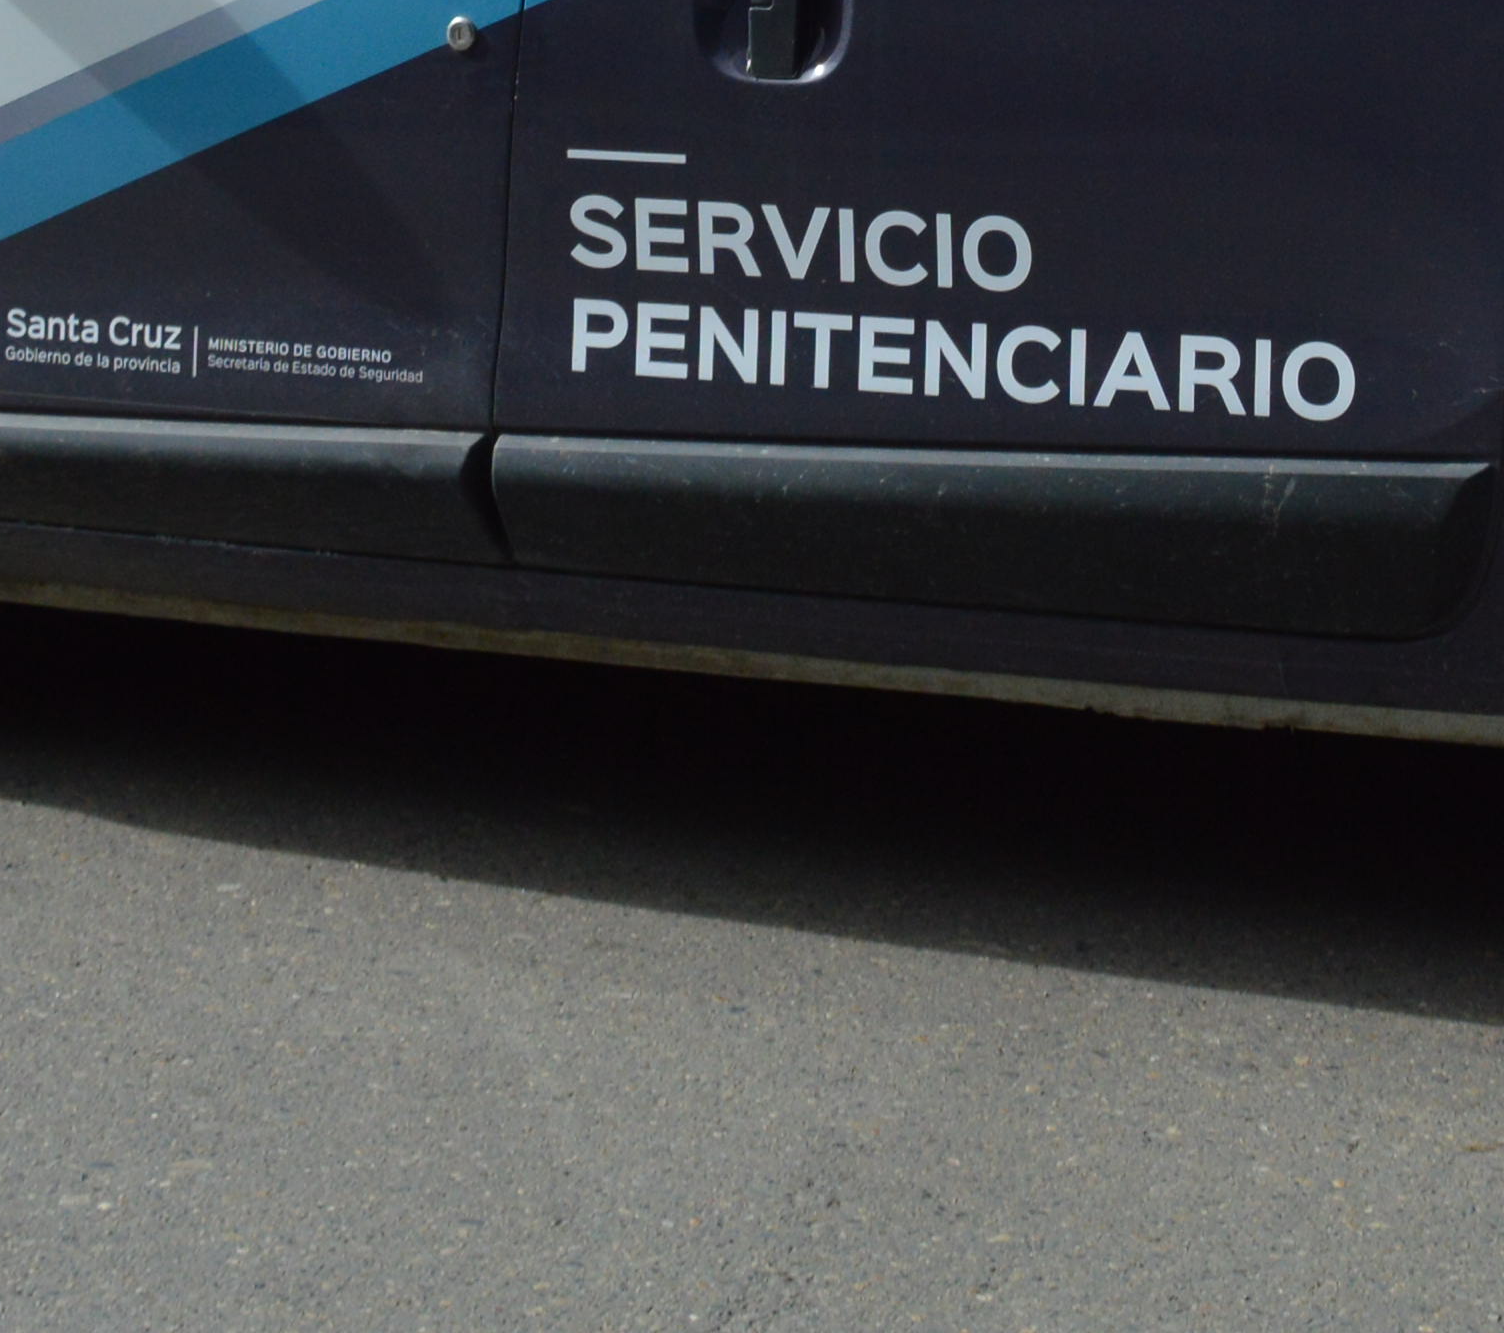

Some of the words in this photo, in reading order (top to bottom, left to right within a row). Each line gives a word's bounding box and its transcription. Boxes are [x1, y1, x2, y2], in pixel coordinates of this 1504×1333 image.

[569, 193, 1033, 293] SERVICIO
[5, 307, 100, 345] Santa
[108, 315, 183, 351] Cruz
[4, 345, 72, 366] Gobierno
[74, 351, 93, 367] de
[97, 353, 110, 369] la
[113, 354, 181, 374] provincia
[207, 336, 289, 357] MINISTERIO
[292, 343, 313, 358] DE
[315, 345, 393, 364] GOBIERNO
[571, 297, 1356, 422] PENITENCIARIO
[273, 358, 289, 374] de
[291, 360, 337, 378] Estado
[339, 363, 356, 379] de
[358, 365, 425, 384] Seguridad
